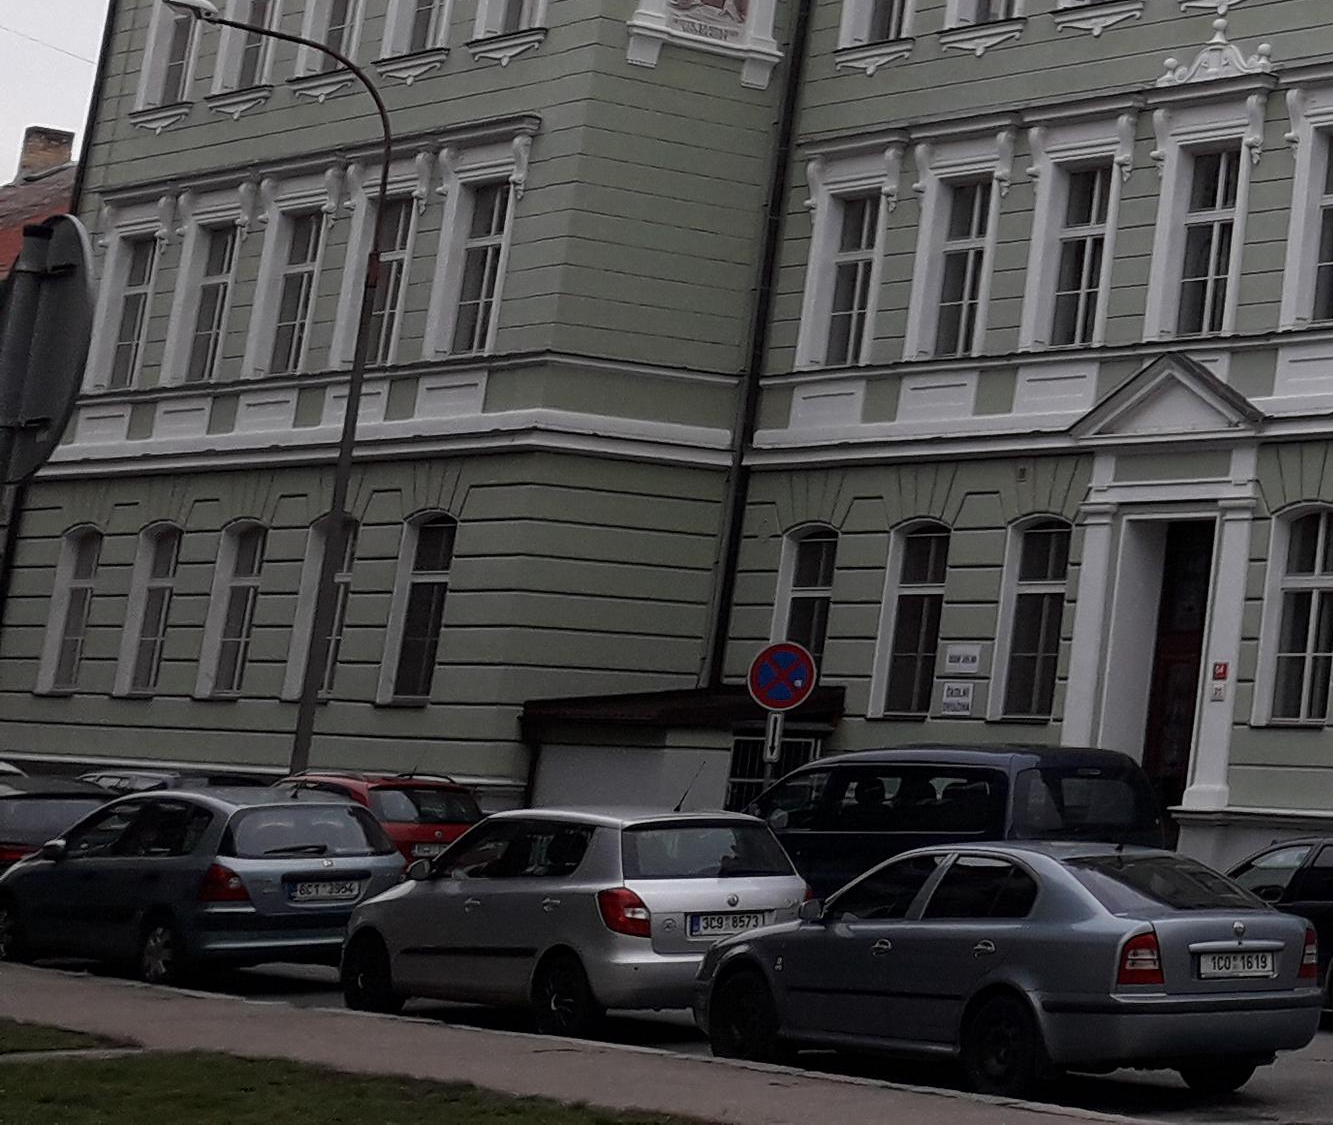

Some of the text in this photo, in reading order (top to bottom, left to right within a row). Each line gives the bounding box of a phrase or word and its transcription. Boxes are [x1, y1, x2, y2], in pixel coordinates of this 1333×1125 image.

[702, 915, 759, 930] 3C9 8573
[1241, 955, 1267, 969] 1619
